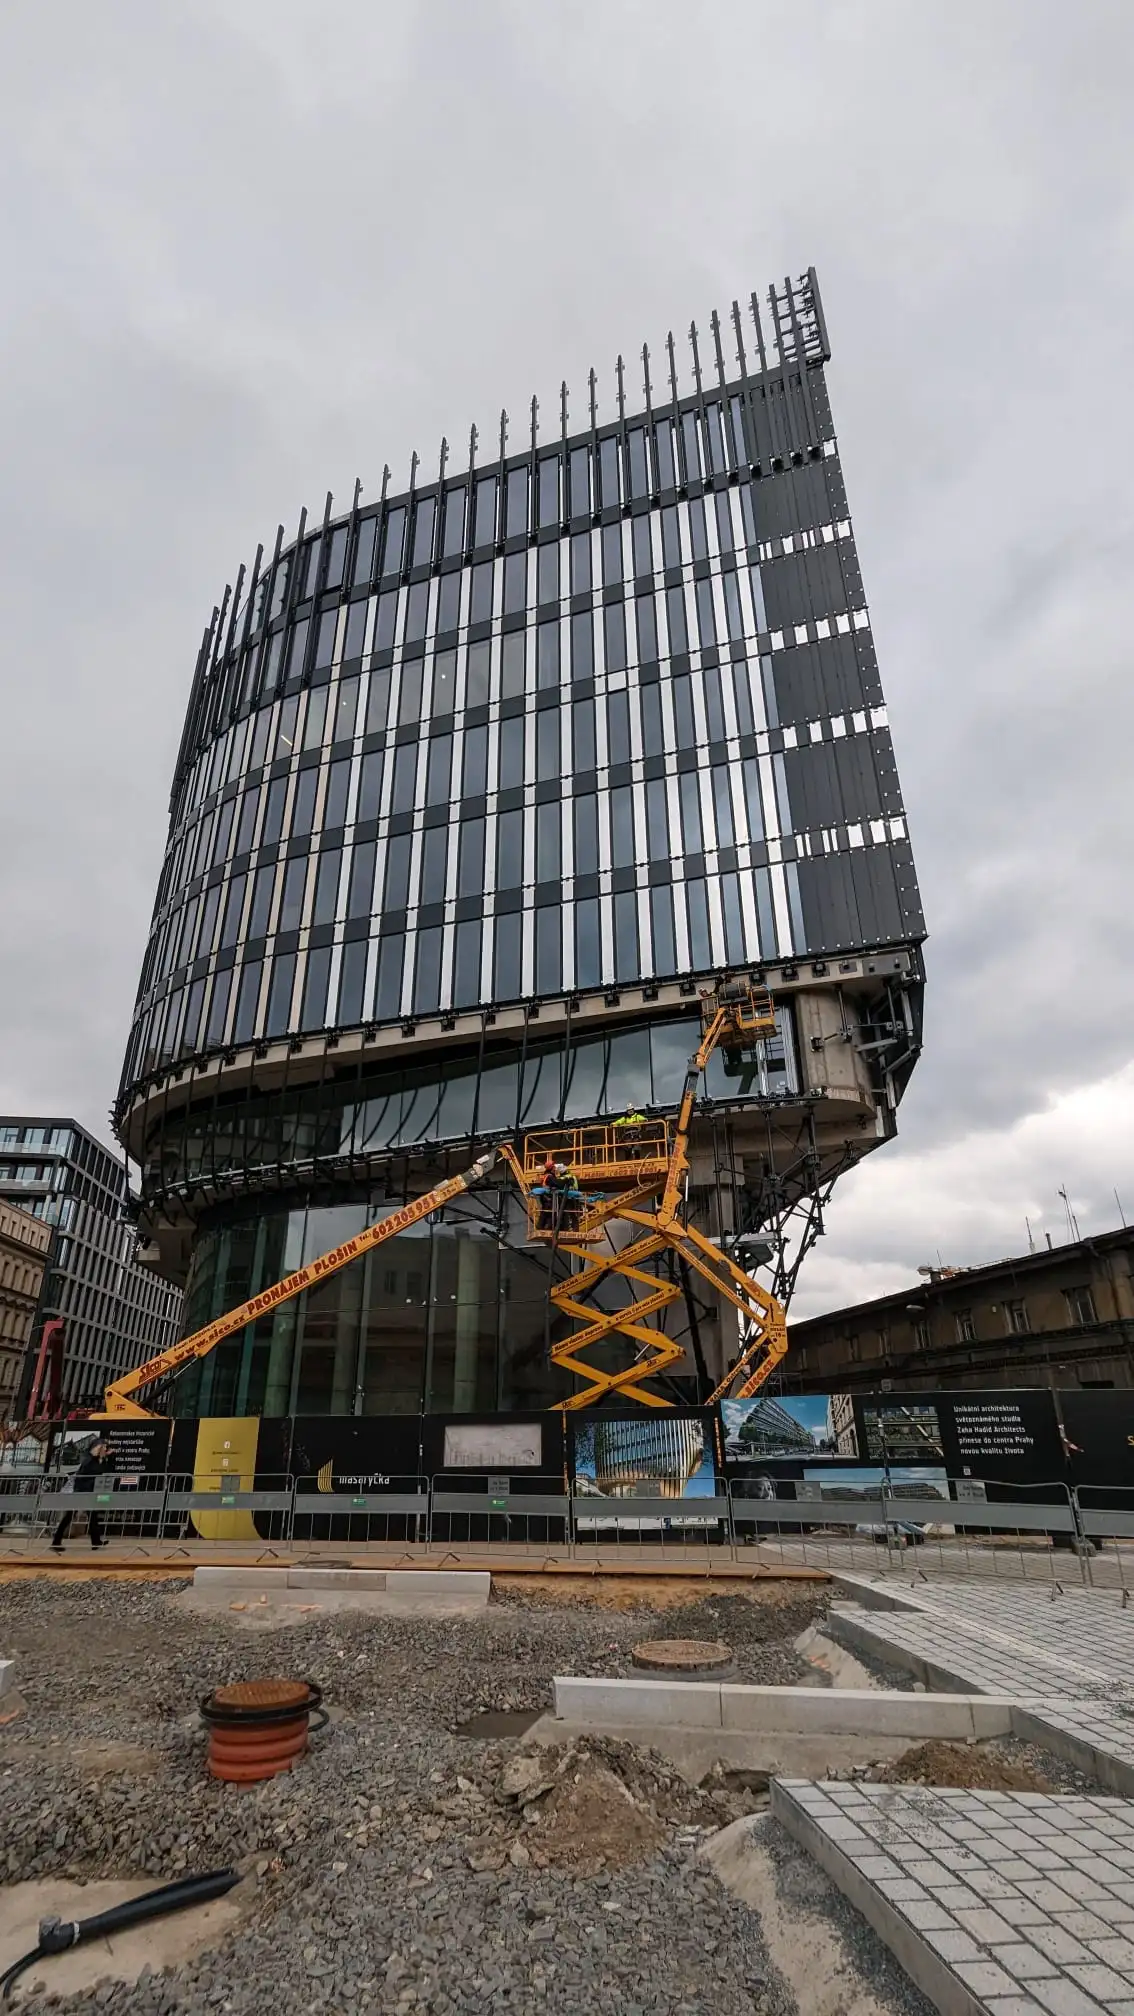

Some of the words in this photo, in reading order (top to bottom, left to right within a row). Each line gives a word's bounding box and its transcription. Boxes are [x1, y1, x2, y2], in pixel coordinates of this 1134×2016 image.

[246, 1270, 310, 1315] PRONÁJEM
[314, 1241, 358, 1275] PLOŠIN
[372, 1221, 394, 1240] 602
[393, 1207, 416, 1227] 205
[415, 1193, 437, 1213] 951
[174, 1314, 245, 1361] www.sico.cz
[953, 1405, 980, 1413] Unikátní
[981, 1404, 1020, 1412] architektura
[957, 1426, 973, 1434] Zaha
[994, 1425, 1026, 1433] Architects
[958, 1437, 982, 1445] přinese
[983, 1436, 992, 1444] do
[1015, 1436, 1034, 1446] Prahy
